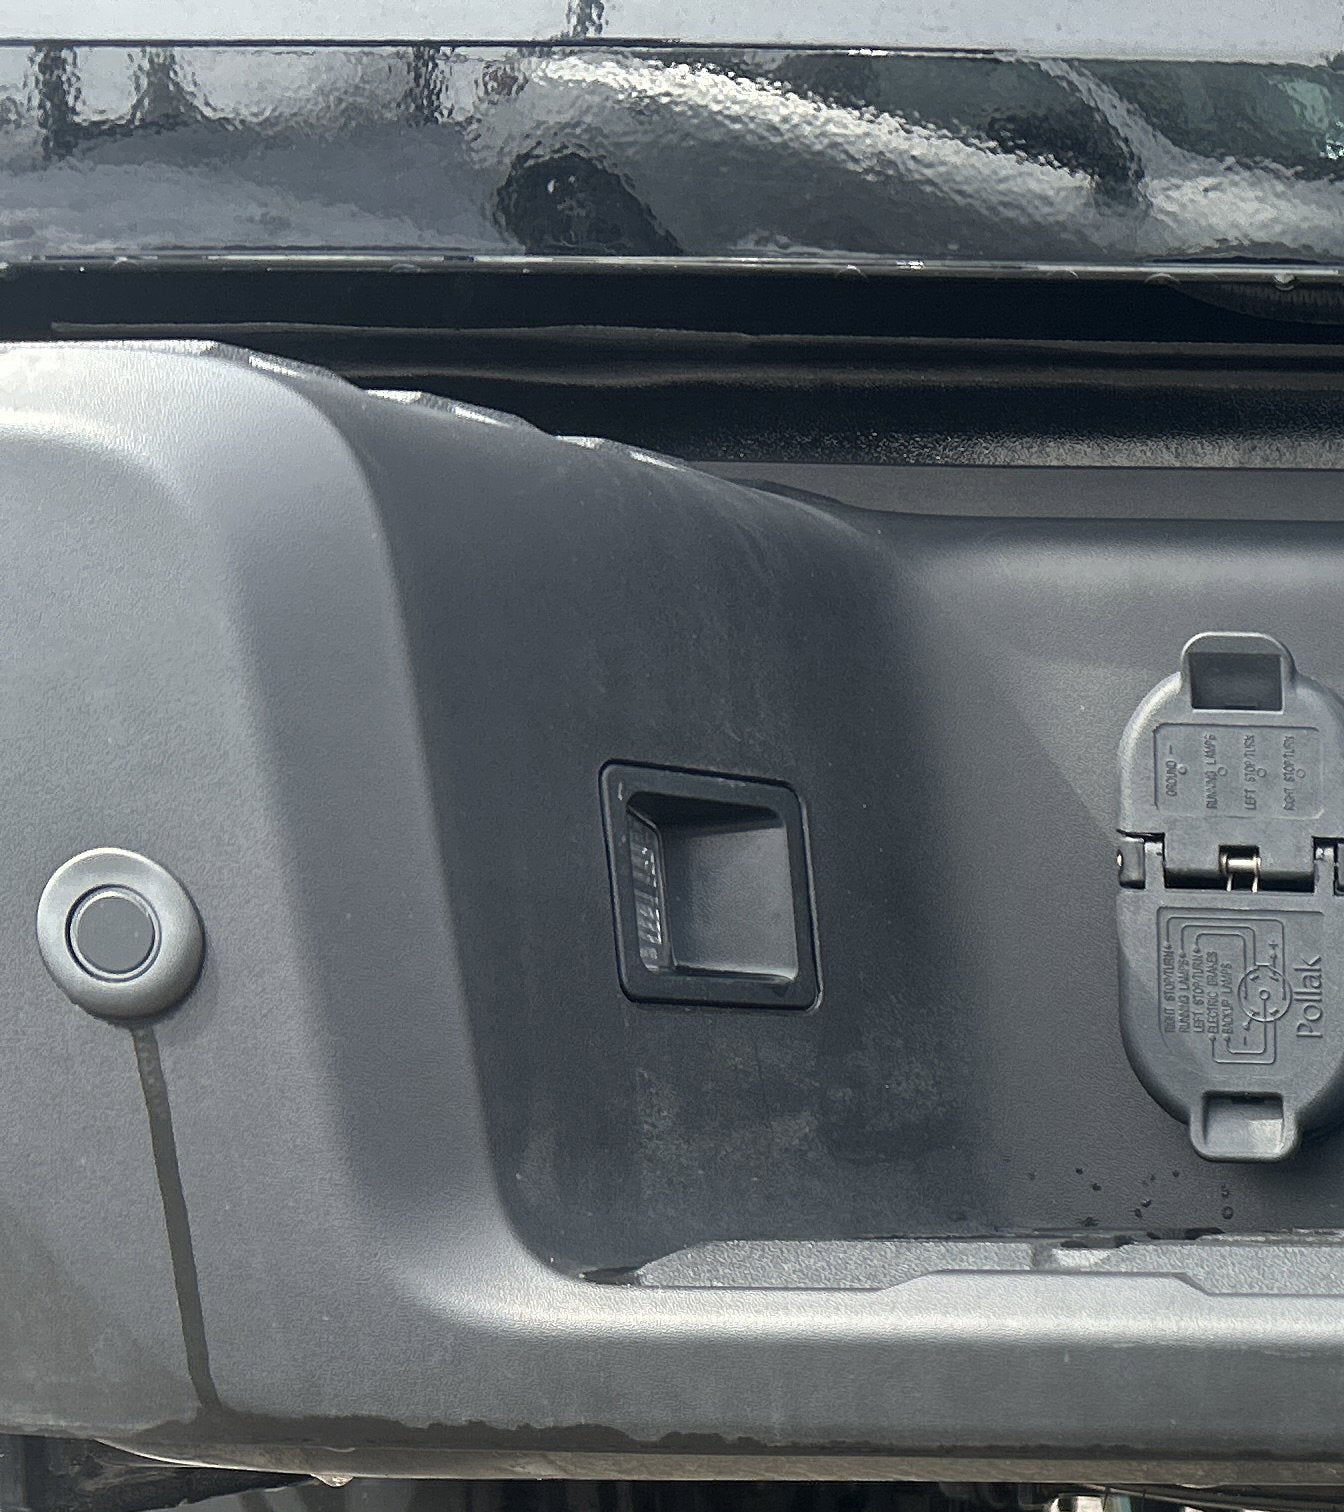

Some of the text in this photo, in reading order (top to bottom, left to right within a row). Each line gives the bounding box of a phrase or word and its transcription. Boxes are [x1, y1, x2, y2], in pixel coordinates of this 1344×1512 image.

[1203, 734, 1217, 766] LAMPS
[1165, 760, 1178, 797] GROUND
[1243, 788, 1256, 811] LEFT
[1178, 958, 1189, 990] LAMPS
[1206, 951, 1219, 1034] ELECTRIC BRAKES
[1220, 962, 1233, 1035] BACKUP LAMPS
[1293, 955, 1322, 1039] Pollak
[1193, 1012, 1205, 1034] LEFT
